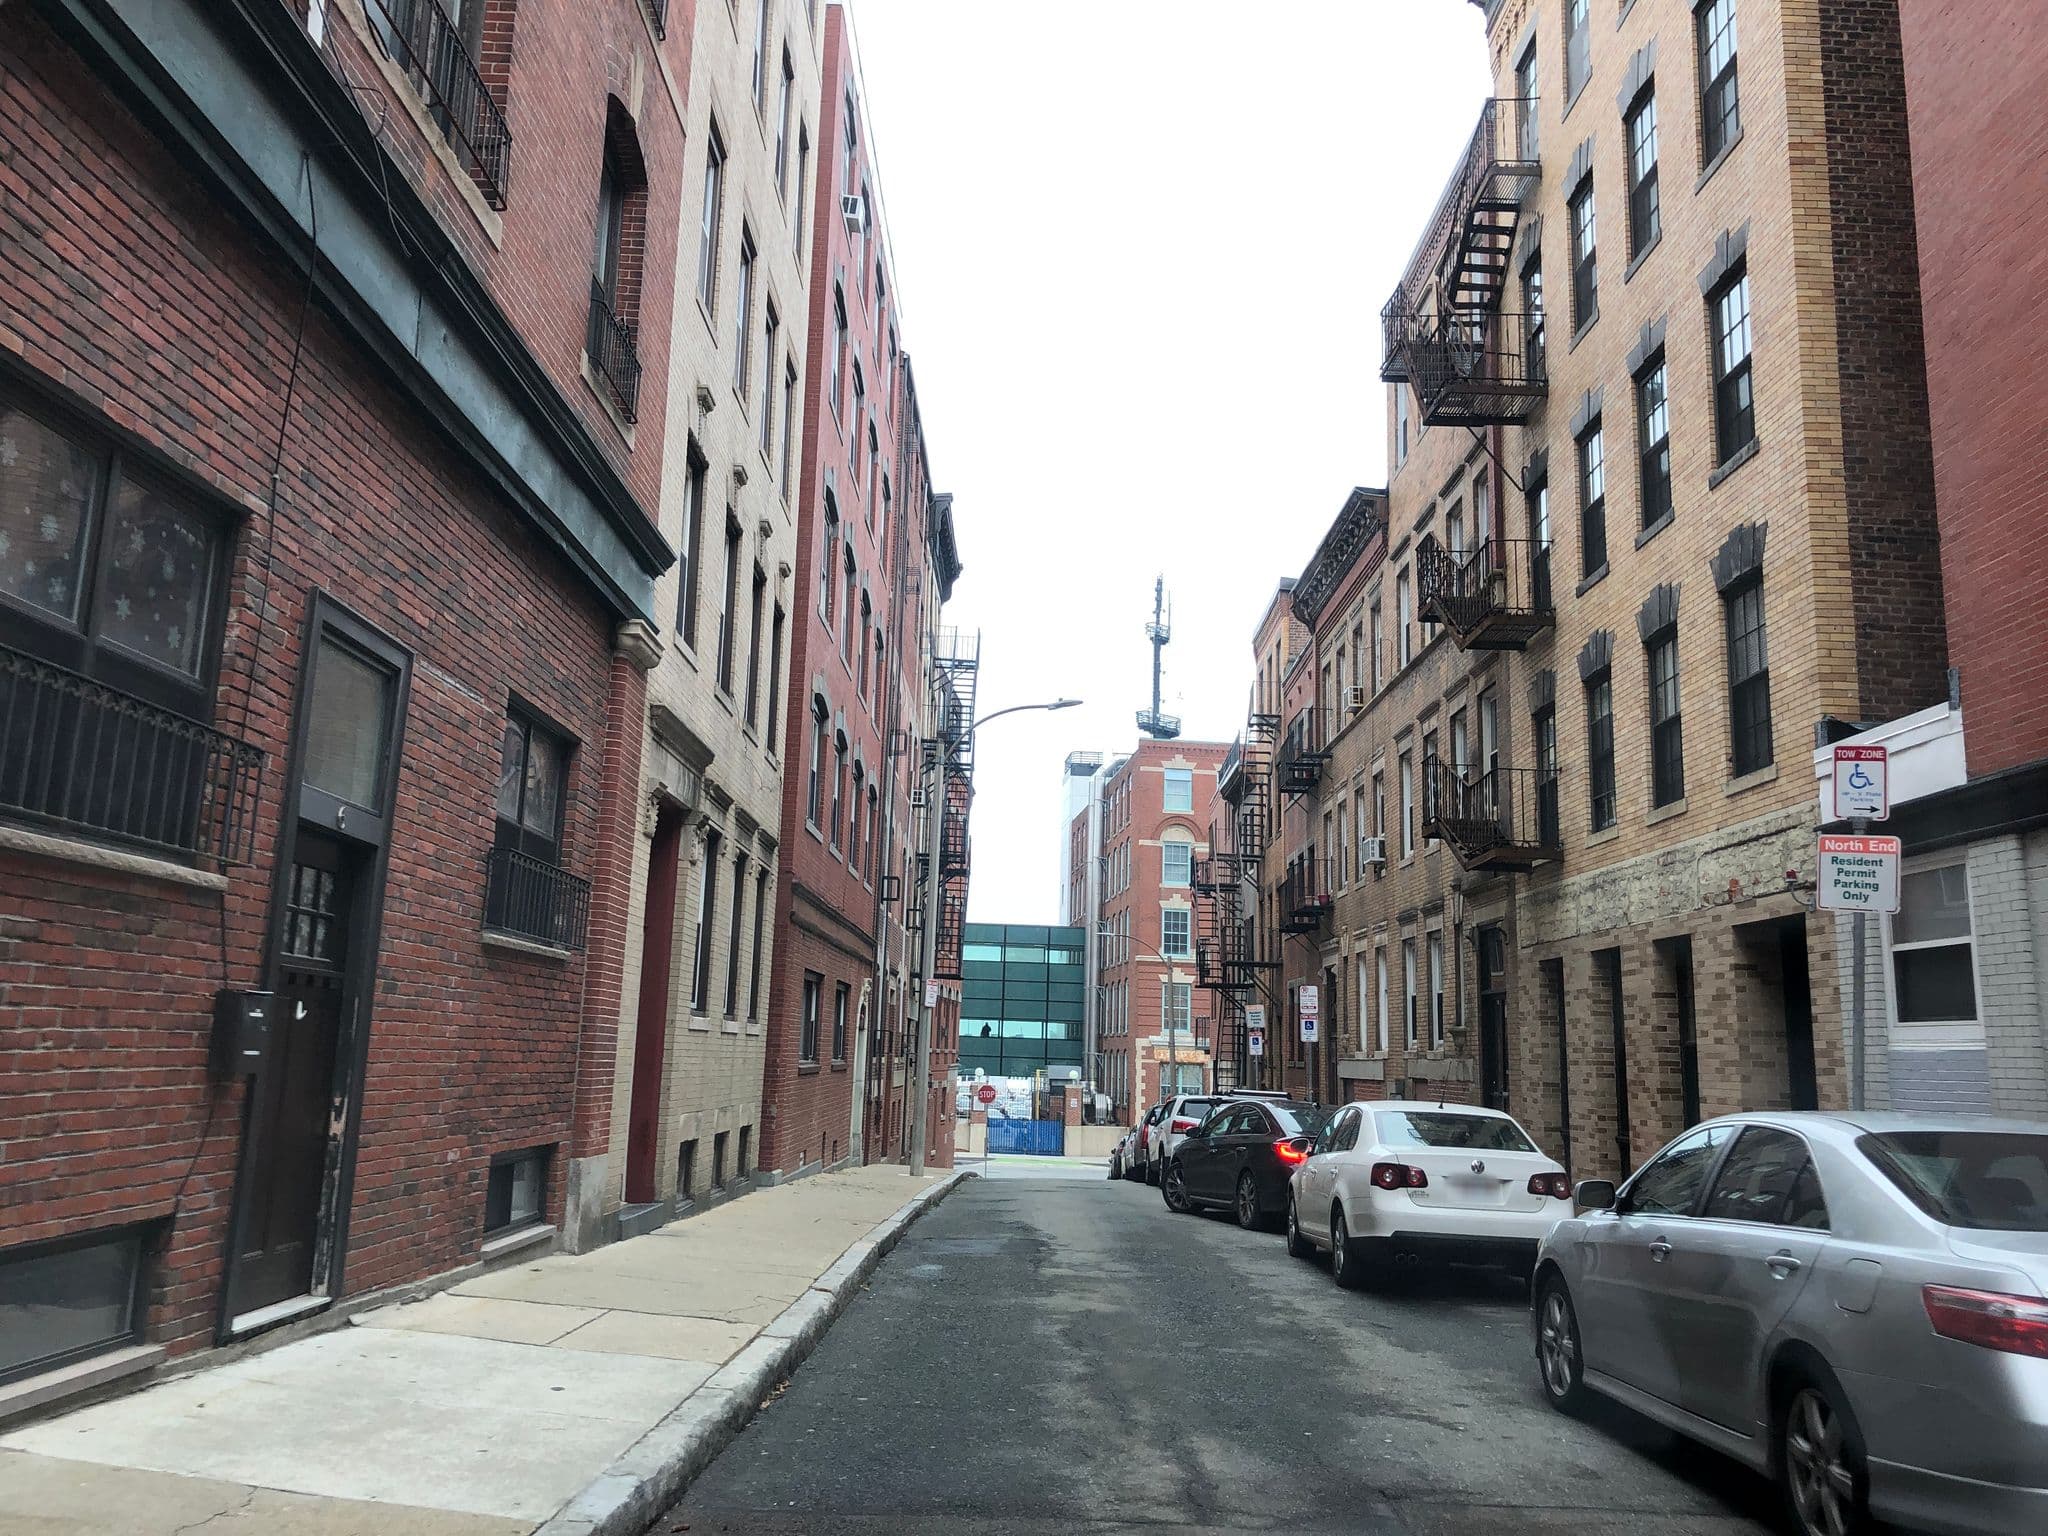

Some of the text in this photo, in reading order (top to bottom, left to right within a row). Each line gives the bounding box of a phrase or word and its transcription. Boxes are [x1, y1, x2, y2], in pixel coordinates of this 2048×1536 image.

[1836, 749, 1885, 759] TOW ZONE
[1825, 839, 1897, 852] North End
[1831, 856, 1884, 867] Resident
[1837, 867, 1877, 878] Permit
[1833, 879, 1880, 892] Parking
[1842, 891, 1870, 903] Only
[979, 1090, 995, 1098] STOP
